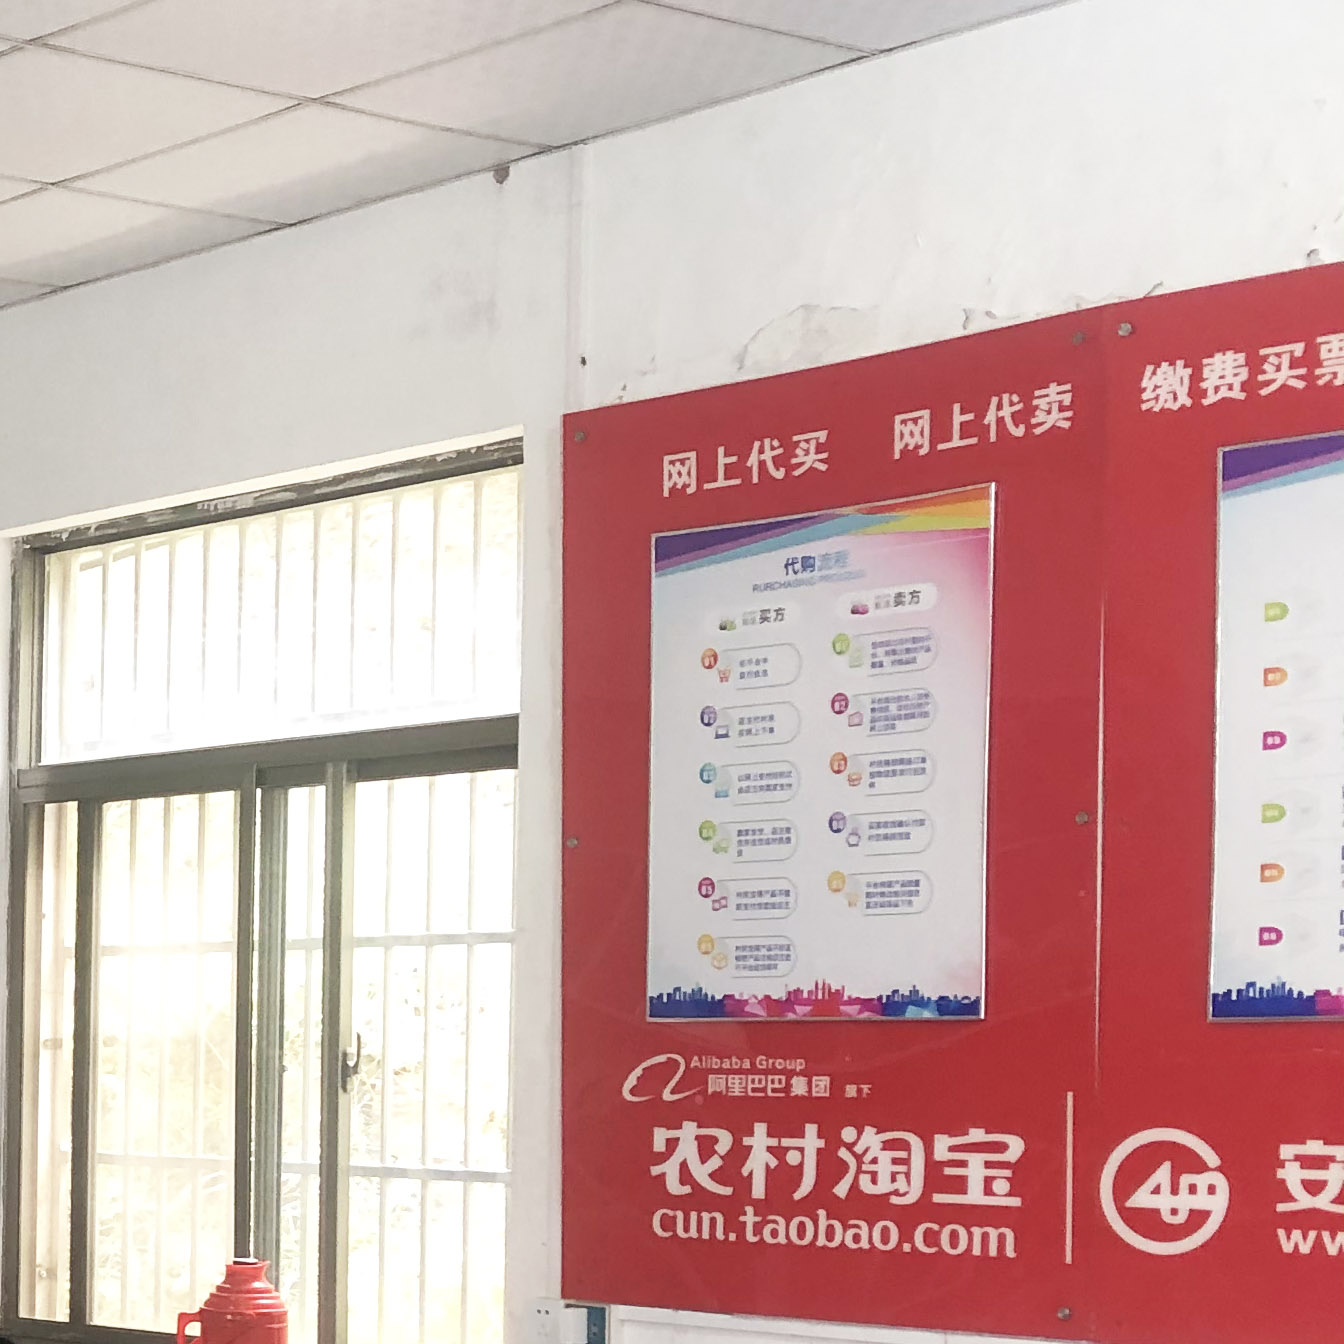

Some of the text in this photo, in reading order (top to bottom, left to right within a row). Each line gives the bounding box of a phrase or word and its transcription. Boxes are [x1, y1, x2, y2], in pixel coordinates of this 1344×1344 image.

[662, 381, 1075, 497] 网上代买 网上代卖
[758, 607, 786, 624] 买方
[691, 1054, 806, 1073] Alibaba Group
[707, 1073, 831, 1098] 阿里巴巴集团
[650, 1120, 1026, 1207] 农村淘宝
[652, 1206, 1018, 1259] cun.taobao.com
